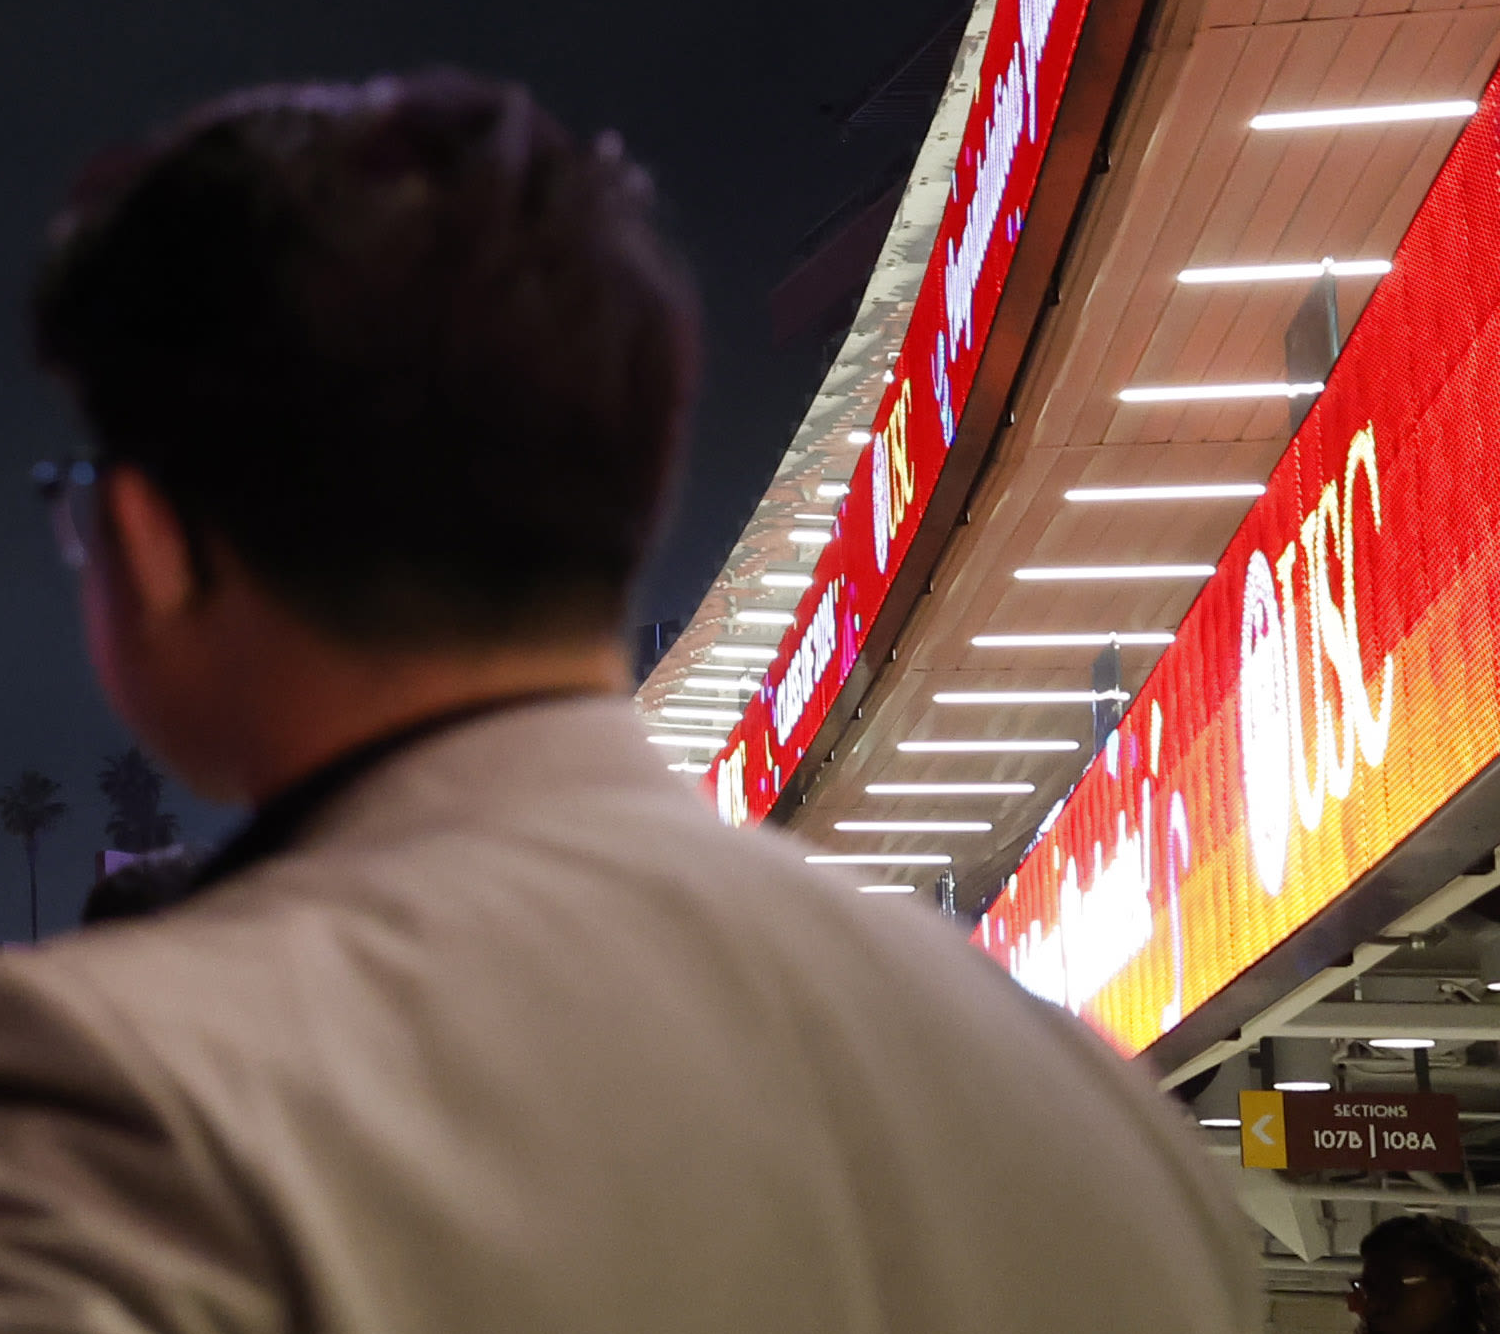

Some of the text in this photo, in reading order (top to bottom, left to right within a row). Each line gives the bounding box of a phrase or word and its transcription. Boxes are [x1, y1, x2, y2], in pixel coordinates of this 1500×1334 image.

[1276, 419, 1394, 832] USC
[1333, 1104, 1408, 1118] SECTIONS
[1313, 1129, 1437, 1151] 107B 108A
